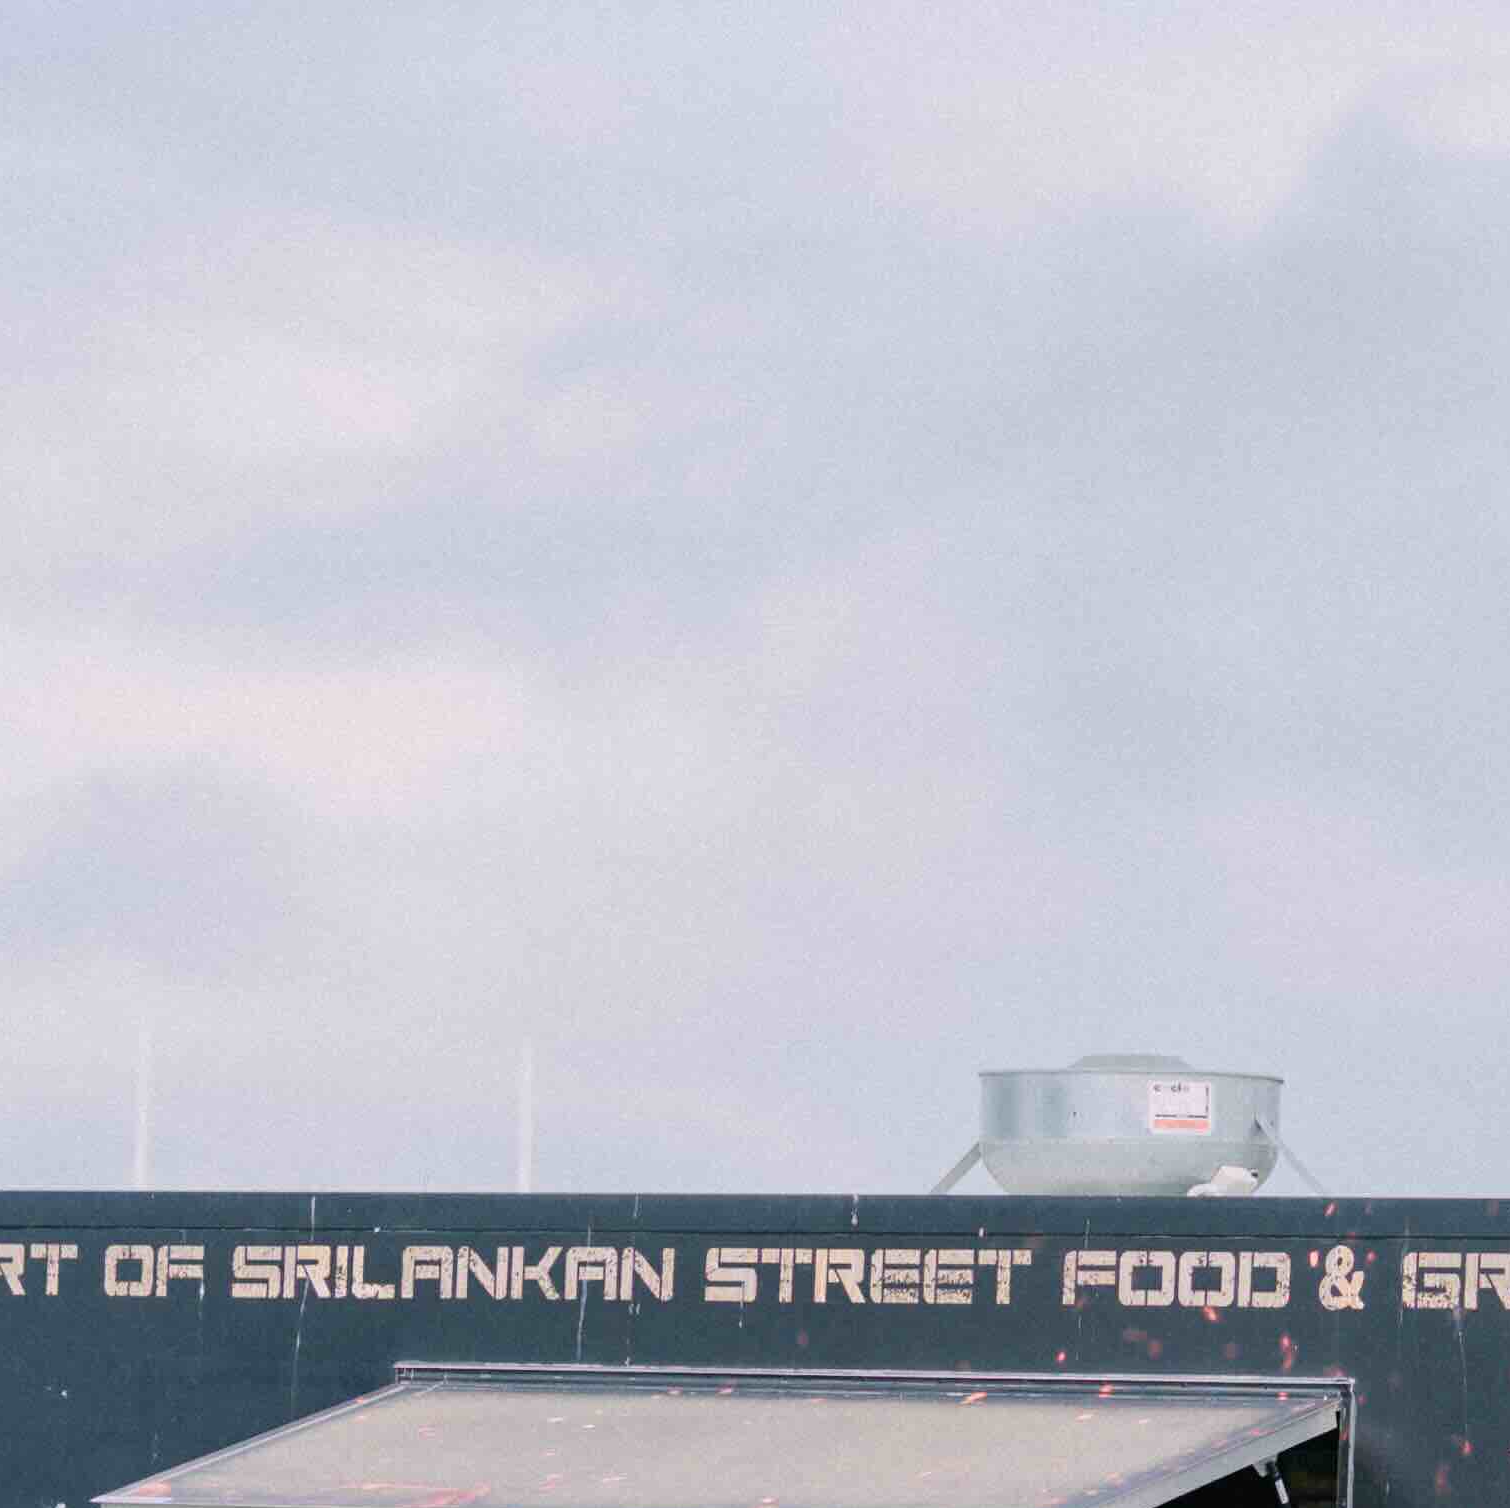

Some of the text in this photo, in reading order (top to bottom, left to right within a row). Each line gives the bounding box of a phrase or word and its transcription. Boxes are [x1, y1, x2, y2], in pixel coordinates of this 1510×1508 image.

[103, 1244, 205, 1297] OF
[231, 1244, 675, 1302] SRILANKAN
[704, 1247, 1032, 1305] STREET
[1062, 1247, 1291, 1308] FOOD
[1318, 1244, 1364, 1311] &
